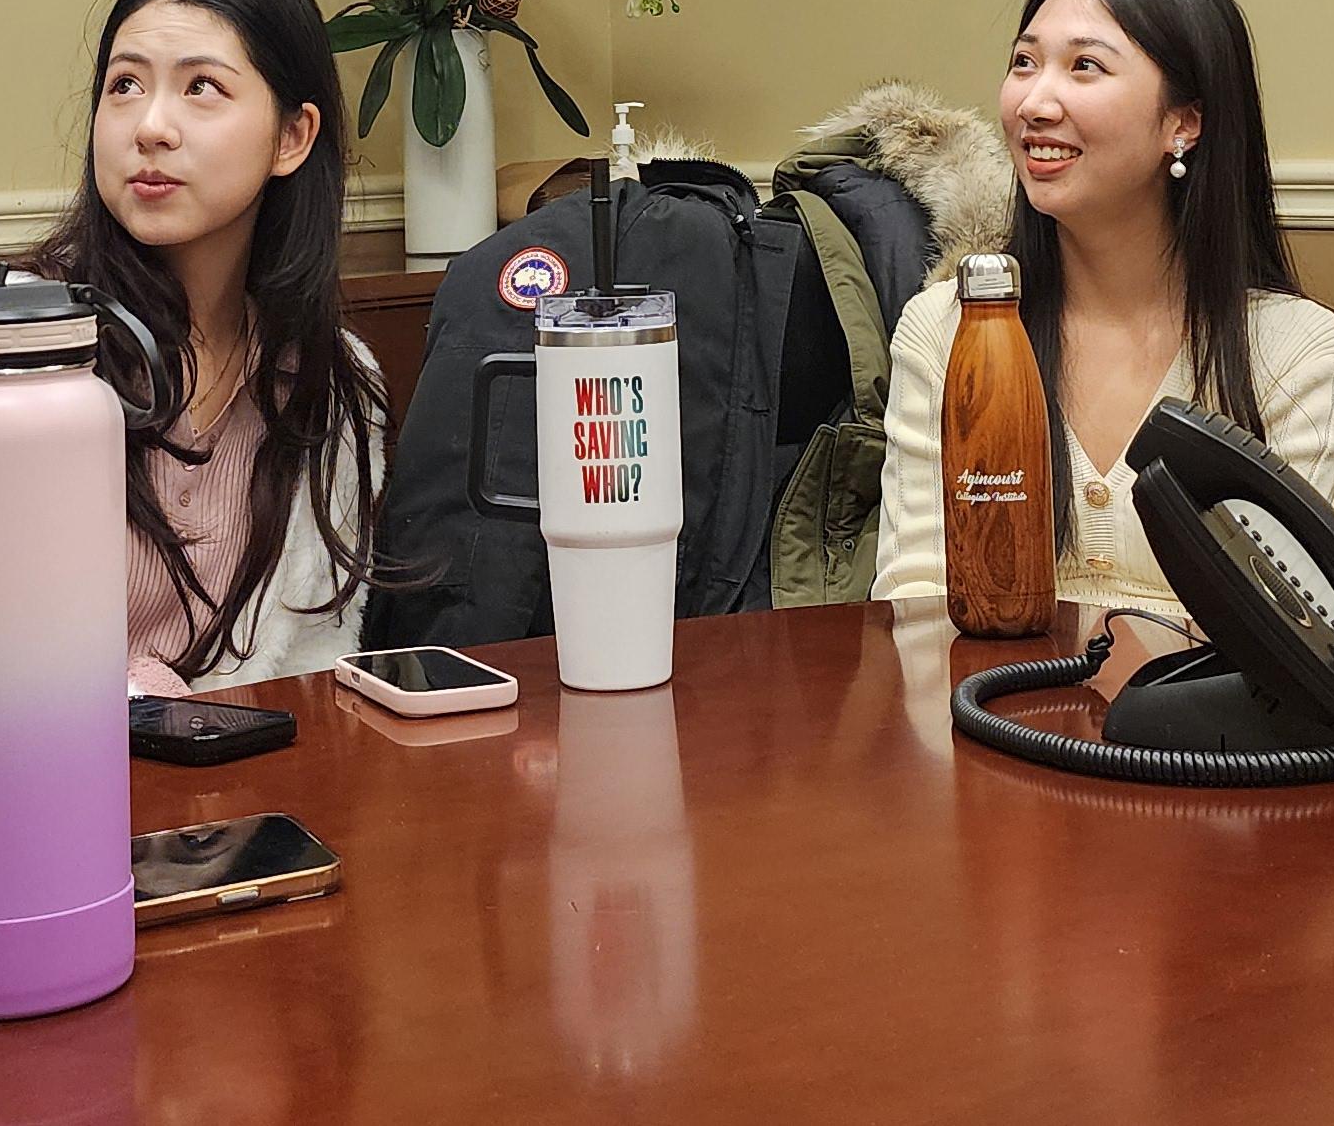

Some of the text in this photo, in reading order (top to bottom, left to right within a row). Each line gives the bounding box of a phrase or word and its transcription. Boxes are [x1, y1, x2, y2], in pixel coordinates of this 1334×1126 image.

[575, 375, 643, 416] WHO'S
[573, 418, 648, 460] SAVING
[581, 463, 642, 504] WHO?
[956, 468, 1025, 491] Agincourt
